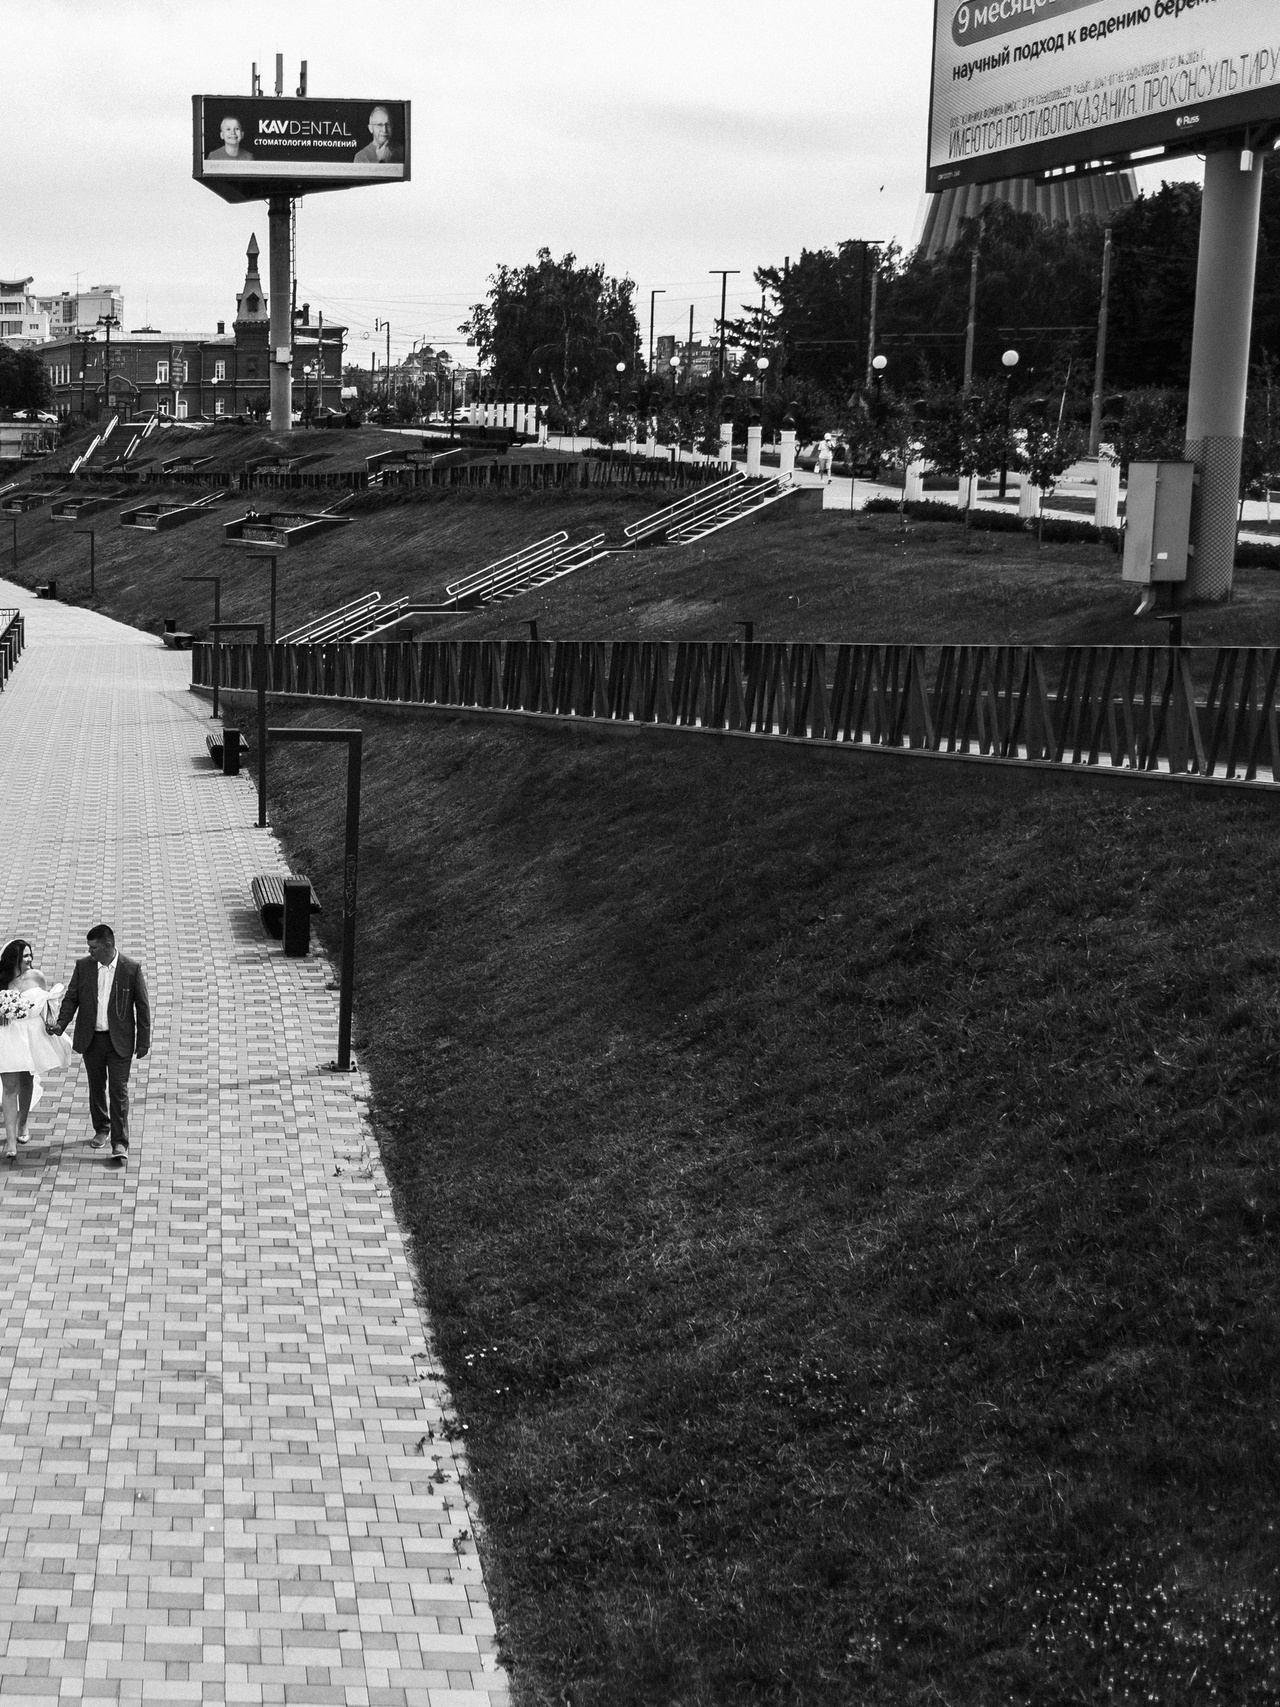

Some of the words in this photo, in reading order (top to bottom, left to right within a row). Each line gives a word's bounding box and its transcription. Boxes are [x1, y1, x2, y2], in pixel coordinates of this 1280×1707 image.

[958, 6, 970, 34] 9
[952, 45, 1010, 81] научный
[1013, 33, 1065, 63] подход
[1067, 29, 1077, 46] к
[1080, 6, 1150, 42] ведению
[254, 138, 311, 147] СТОМАТОЛОГИЯ
[312, 139, 357, 148] ПОКОЛЕНИЙ
[948, 119, 1003, 159] ИМЕЮТСЯ
